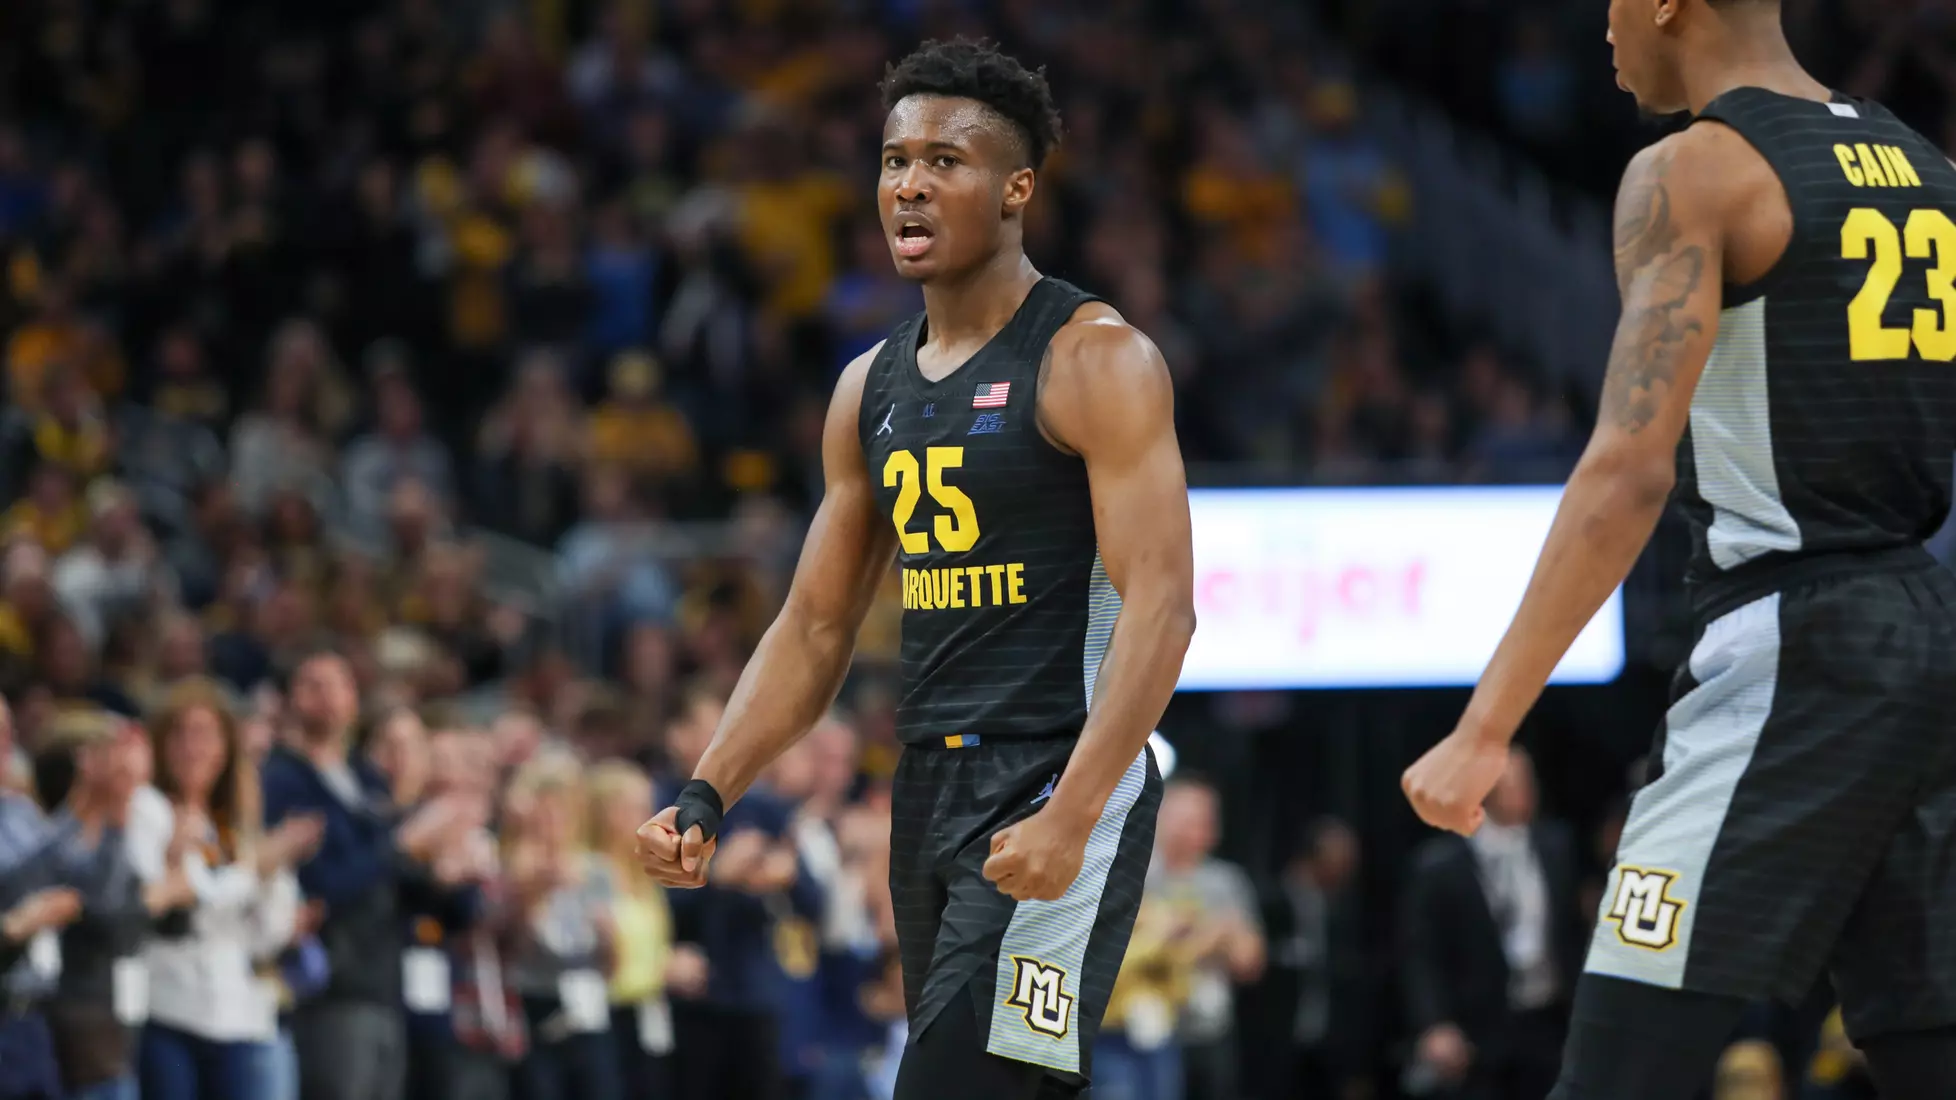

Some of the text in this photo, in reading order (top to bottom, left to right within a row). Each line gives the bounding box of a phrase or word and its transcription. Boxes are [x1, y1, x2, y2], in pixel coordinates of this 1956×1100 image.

[1833, 143, 1922, 187] CAIN
[1840, 207, 1956, 362] 23
[968, 422, 1006, 434] EAST
[976, 413, 1001, 423] BIG
[883, 446, 981, 555] 25
[902, 562, 1028, 610] ARQUETTE
[1604, 865, 1688, 952] MU
[1004, 954, 1075, 1040] MU
